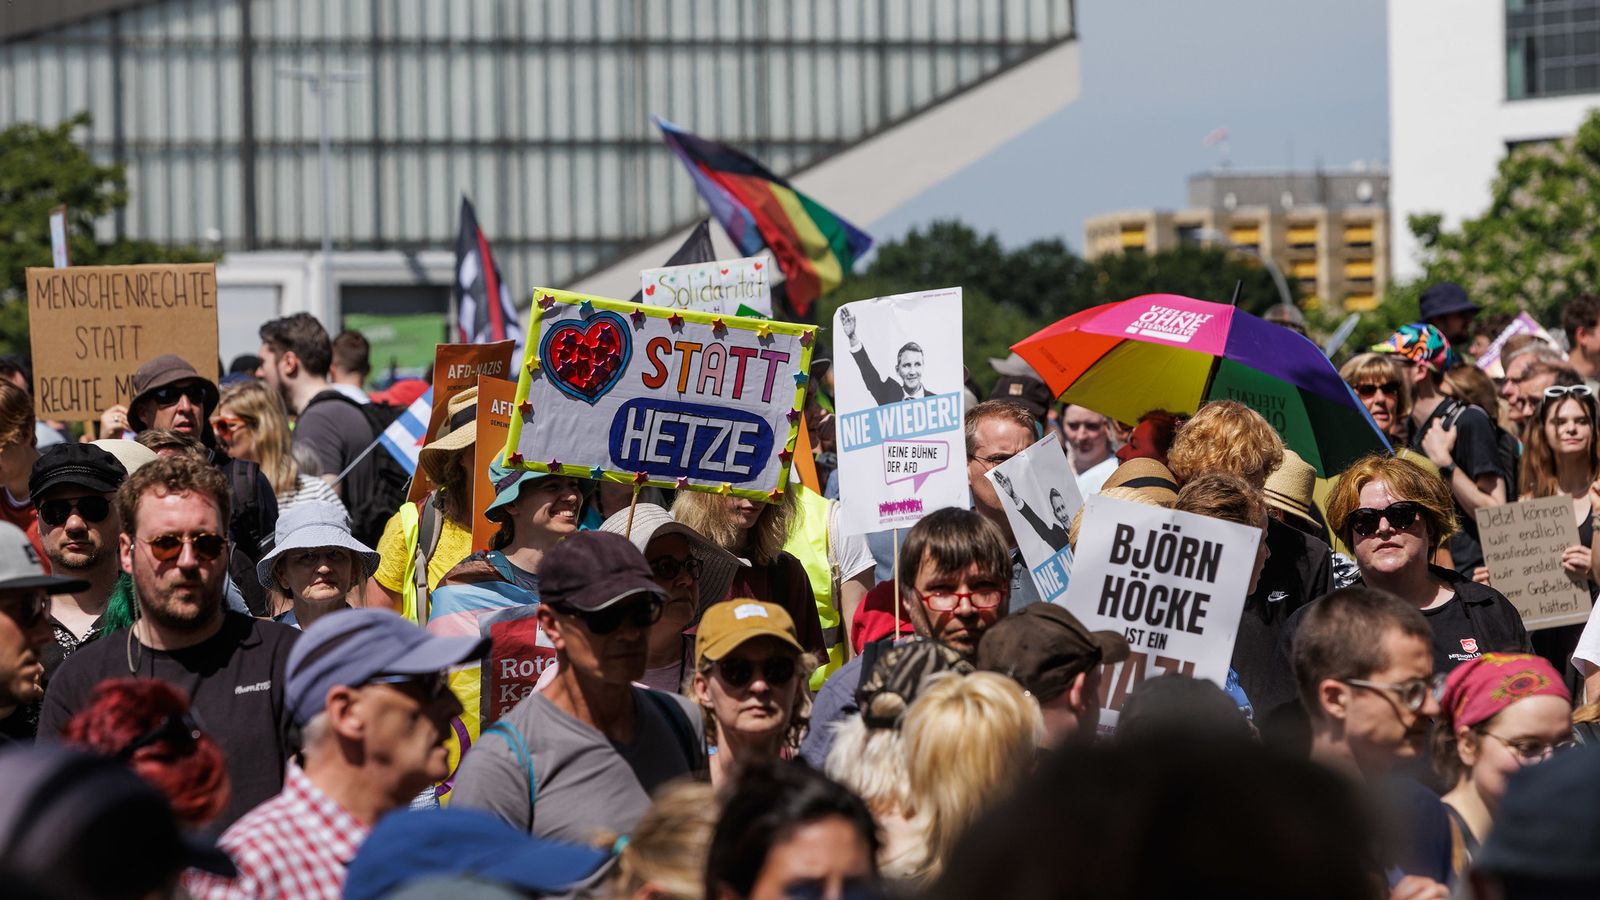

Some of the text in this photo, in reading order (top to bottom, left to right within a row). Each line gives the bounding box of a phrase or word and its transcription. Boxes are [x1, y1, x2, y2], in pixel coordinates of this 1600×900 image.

[36, 271, 213, 311] MENSCHENRECHTE
[653, 270, 765, 307] Solidarität
[1139, 311, 1200, 331] OHNE
[1150, 305, 1214, 323] VIELFALT
[1130, 320, 1197, 337] ALTERNATIVE
[75, 325, 143, 361] STATT
[447, 361, 502, 379] AFD-NAZIS
[641, 336, 790, 403] STATT
[40, 376, 104, 413] RECHTE
[842, 395, 958, 448] NIE WIEDER!
[620, 406, 759, 475] HETZE
[887, 445, 938, 459] KEINE BÜHNE
[887, 461, 917, 473] DER AFD
[1478, 504, 1569, 530] Jetzt können
[1488, 520, 1565, 546] wir endlich
[1109, 523, 1223, 583] BJÖRN
[1035, 561, 1065, 598] NIE
[1494, 569, 1513, 581] wir
[1097, 571, 1211, 635] HÖCKE
[1539, 594, 1578, 616] hätten!
[1124, 627, 1168, 650] IST EIN
